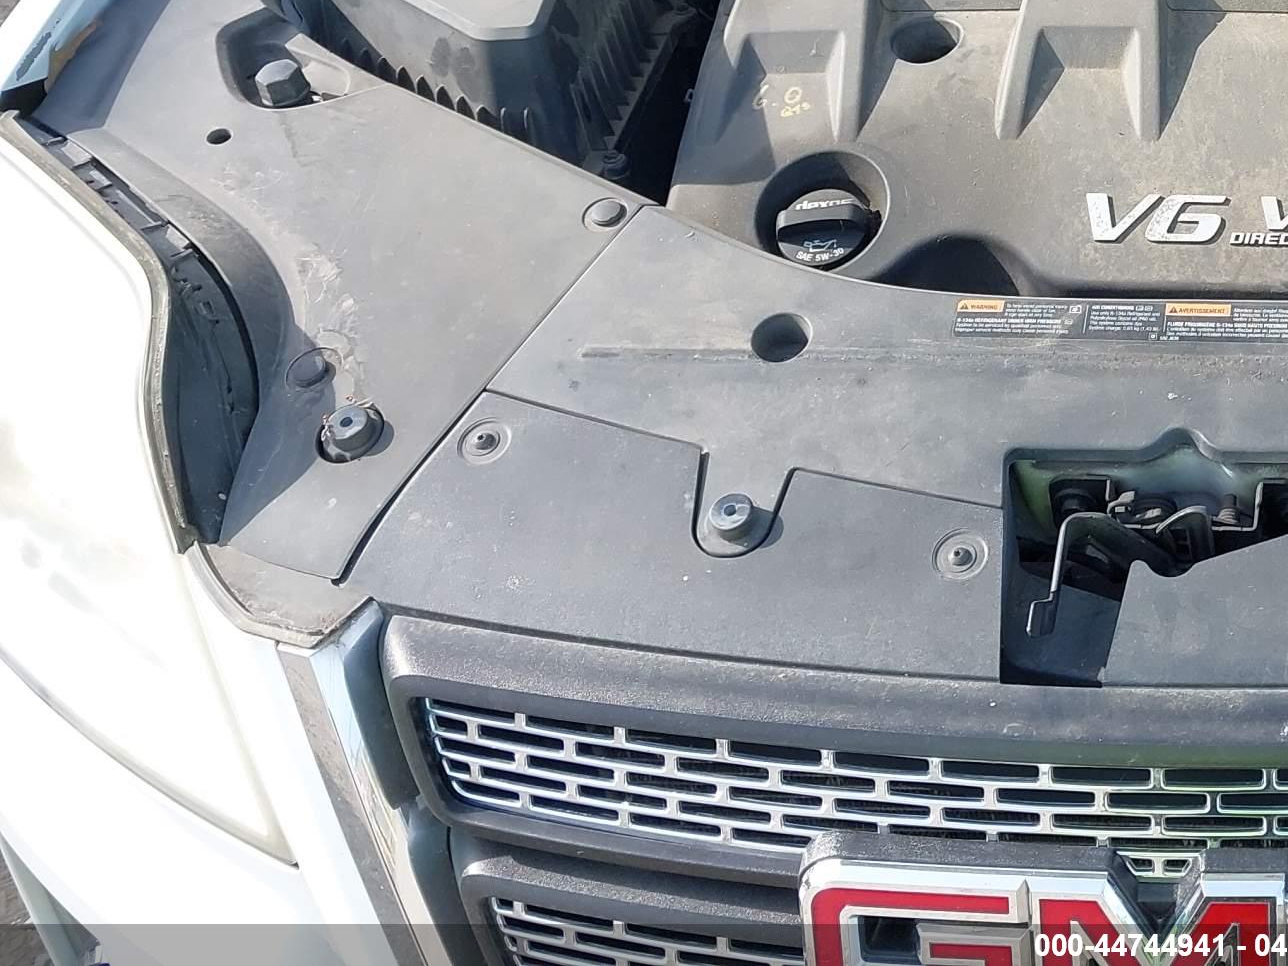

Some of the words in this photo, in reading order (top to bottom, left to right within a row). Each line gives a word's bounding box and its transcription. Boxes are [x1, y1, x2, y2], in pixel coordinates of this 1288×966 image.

[1086, 192, 1232, 245] V6
[795, 250, 814, 263] SAE
[815, 247, 845, 263] 5W-30
